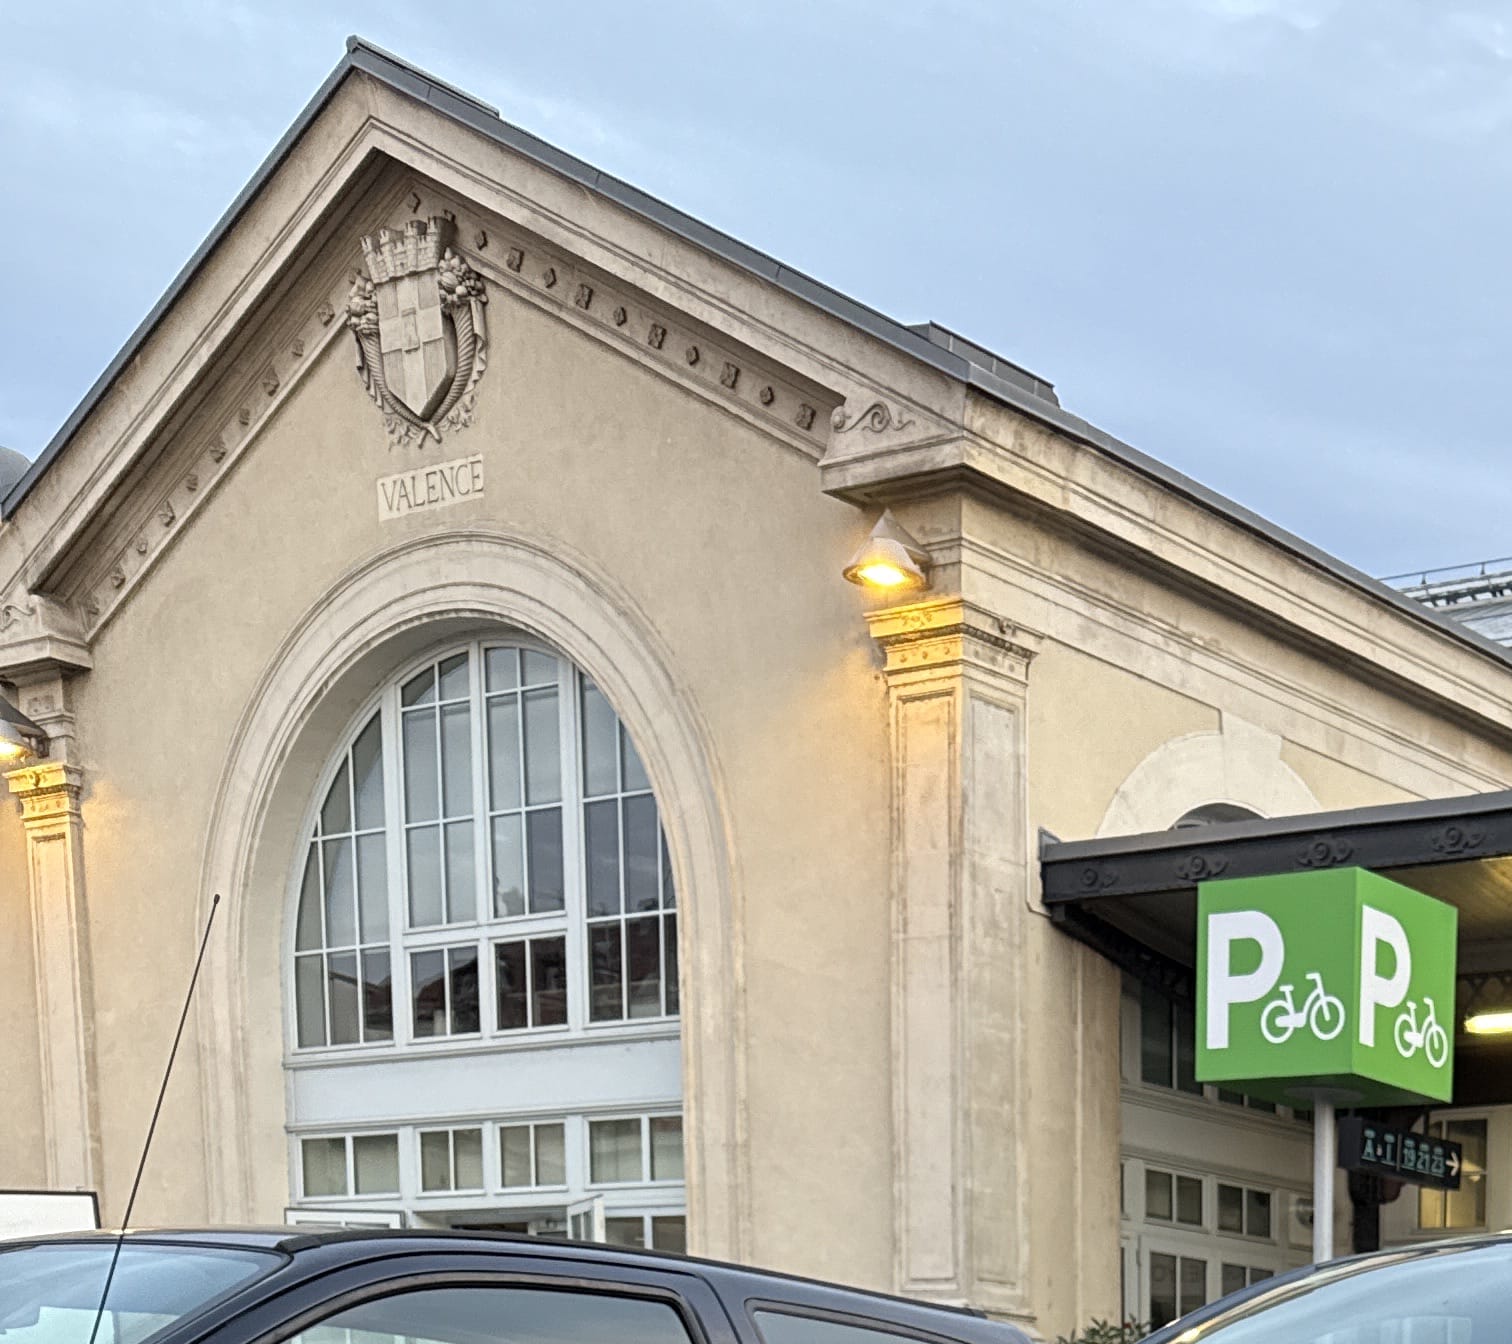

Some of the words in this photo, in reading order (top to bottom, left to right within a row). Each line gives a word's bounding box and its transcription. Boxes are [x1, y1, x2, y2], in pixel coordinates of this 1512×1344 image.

[380, 460, 484, 511] VALENCE
[1206, 910, 1285, 1049] P
[1359, 904, 1411, 1048] P
[1363, 1138, 1375, 1159] A
[1403, 1148, 1415, 1168] 19
[1417, 1151, 1430, 1171] 21
